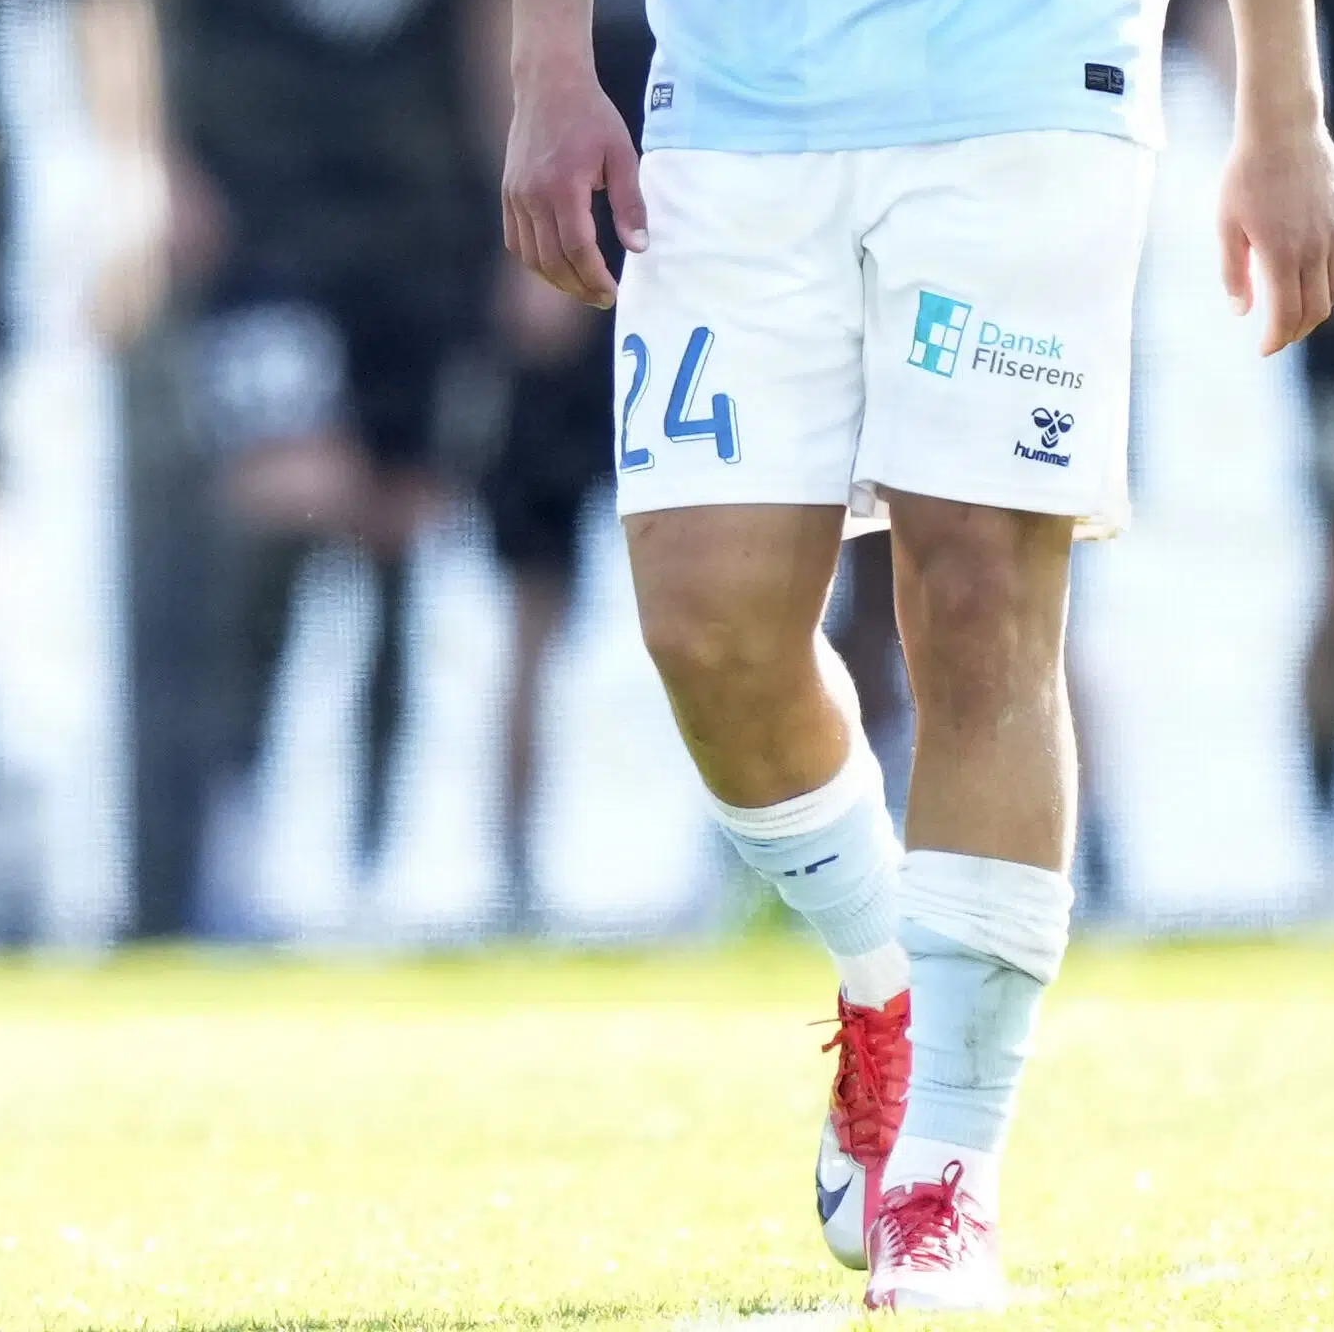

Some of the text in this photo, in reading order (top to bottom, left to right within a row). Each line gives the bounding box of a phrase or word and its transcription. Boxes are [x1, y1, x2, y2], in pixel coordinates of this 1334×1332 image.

[978, 321, 1066, 360] Dansk
[971, 347, 1085, 390] Fliserens
[619, 326, 742, 474] 24
